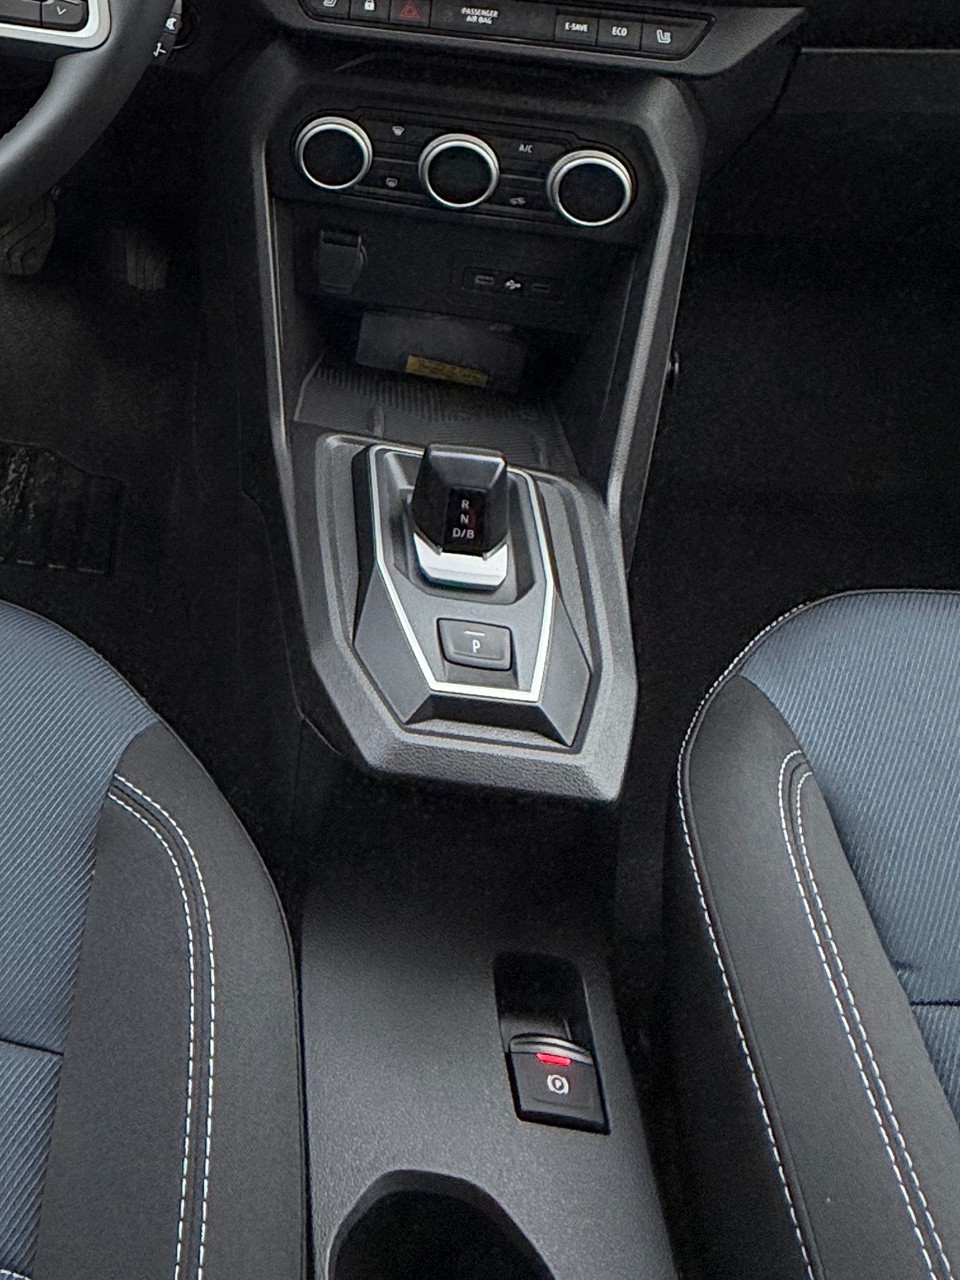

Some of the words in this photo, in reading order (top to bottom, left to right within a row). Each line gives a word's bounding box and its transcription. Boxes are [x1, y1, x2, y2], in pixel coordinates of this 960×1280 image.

[611, 26, 627, 37] ECO
[518, 143, 533, 154] A/C
[461, 499, 470, 510] R
[460, 513, 469, 524] N
[452, 527, 475, 539] D/B
[471, 638, 481, 654] P
